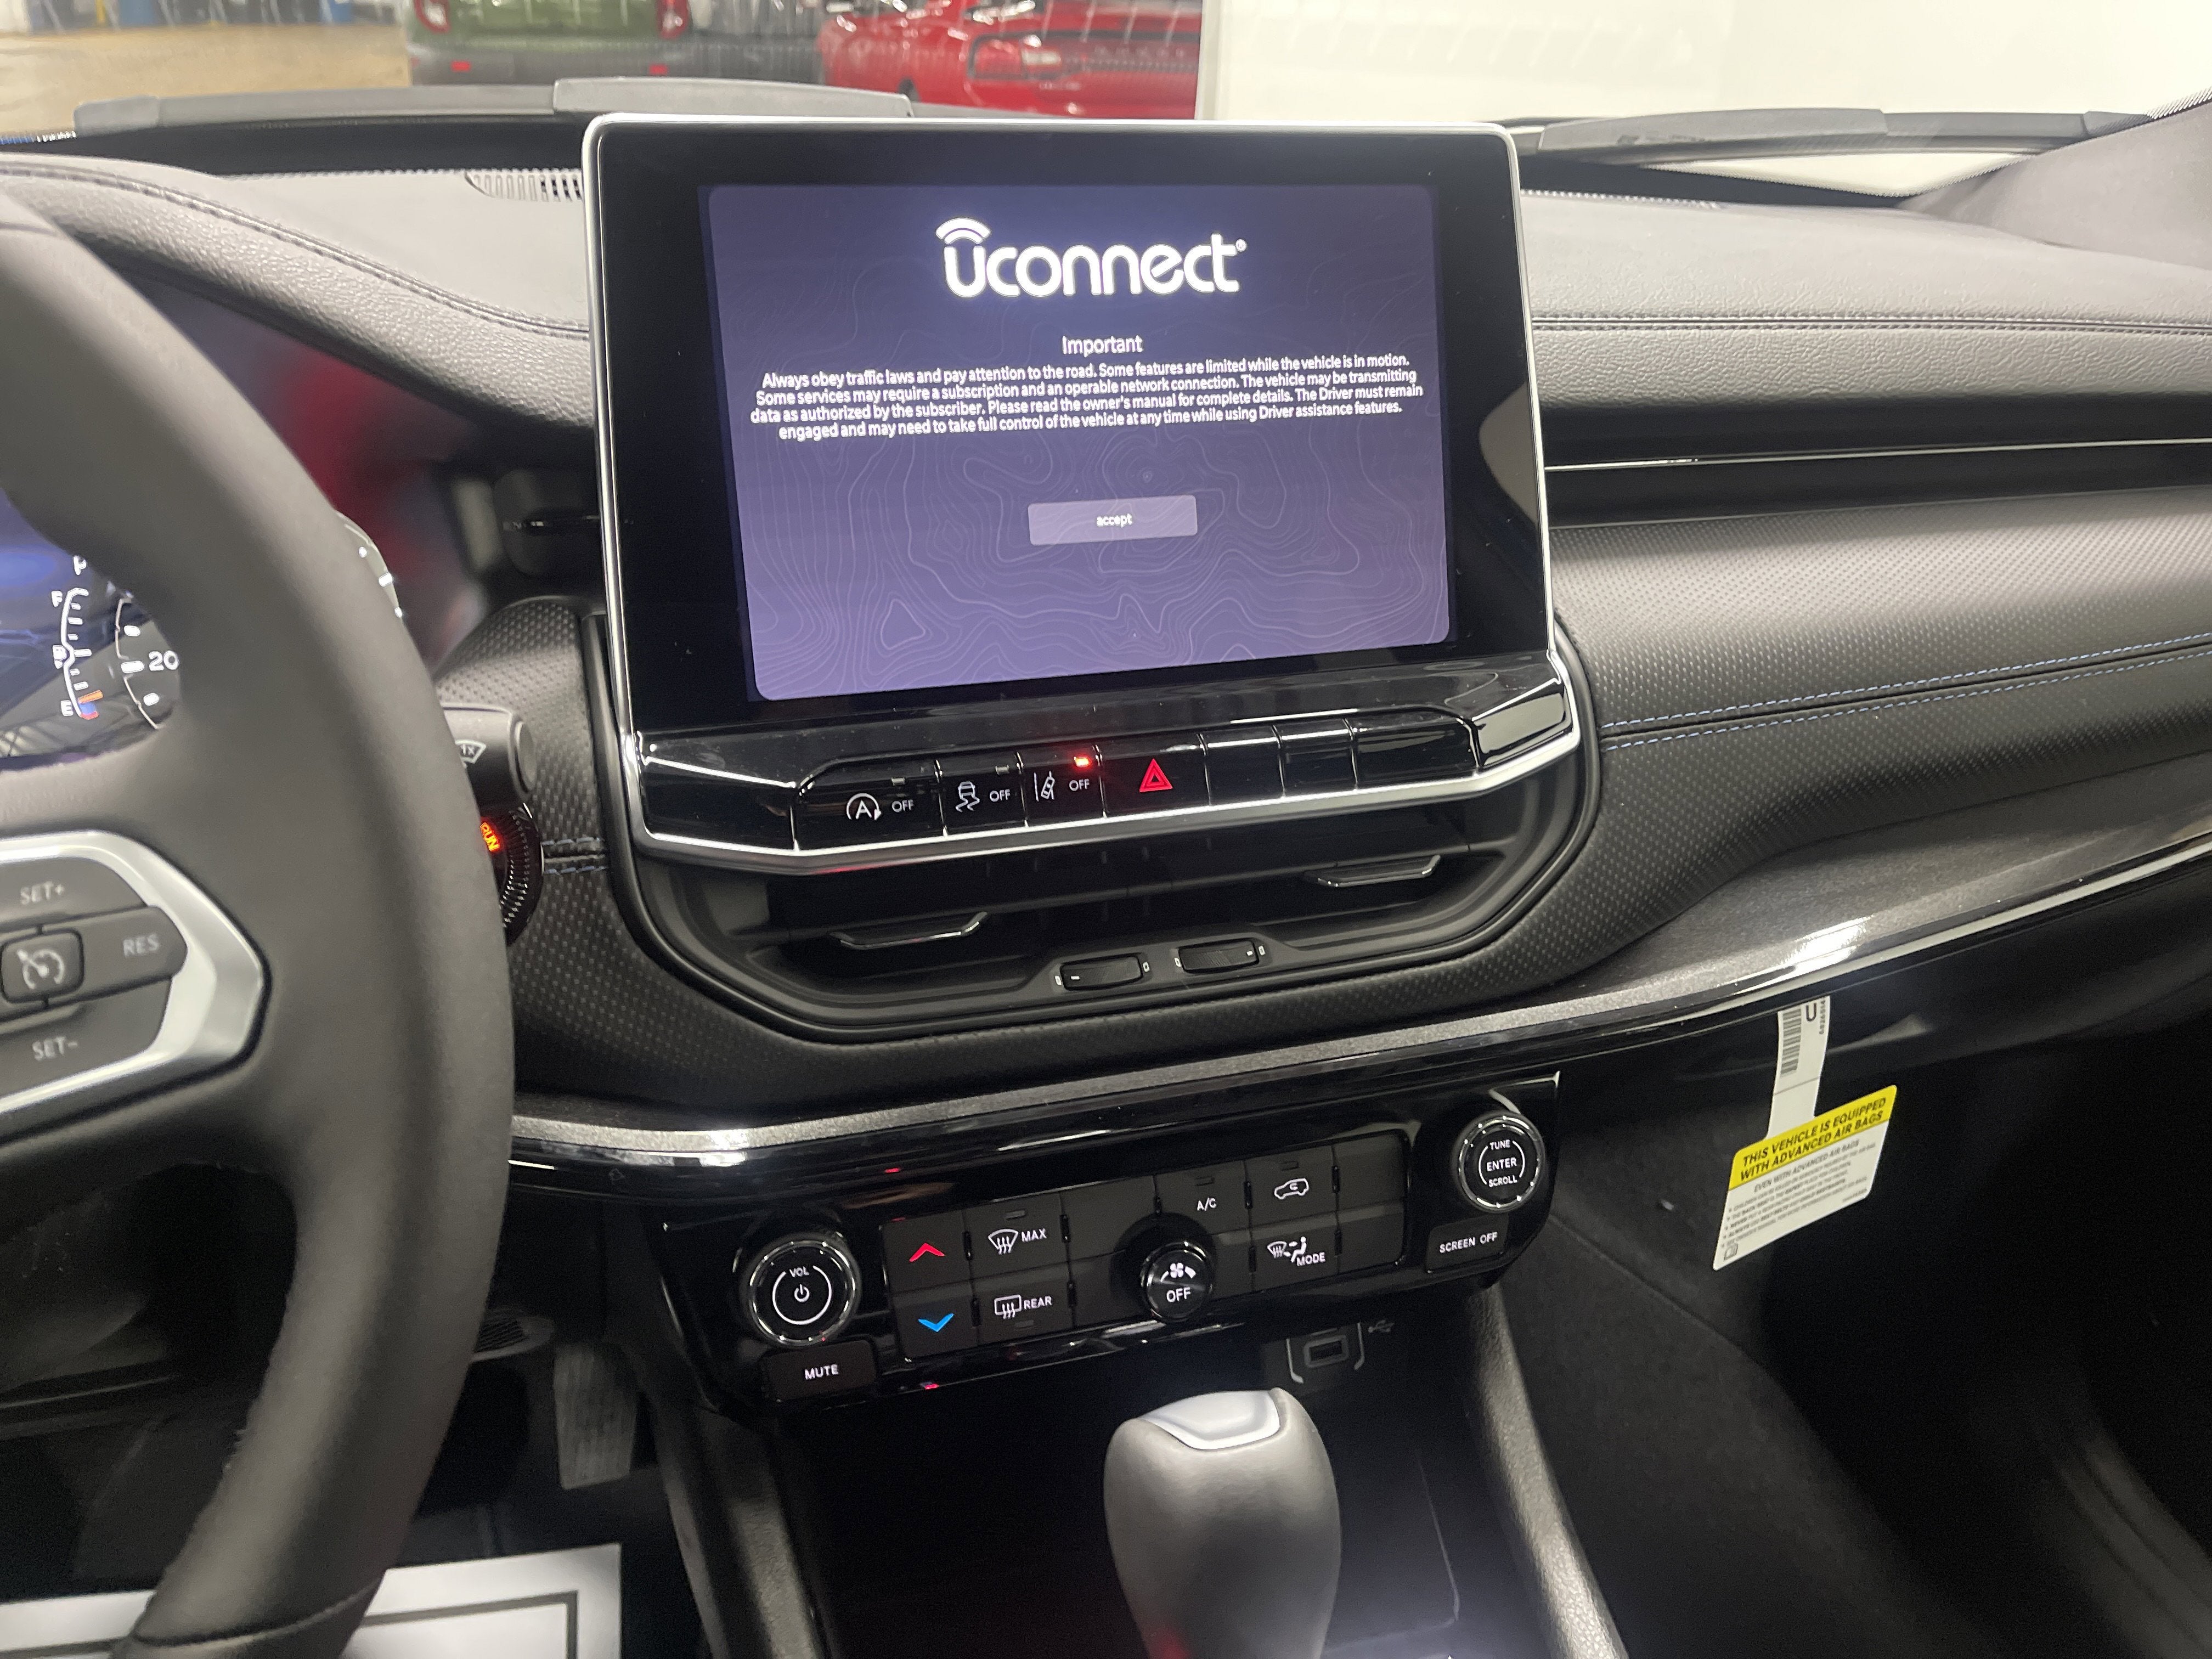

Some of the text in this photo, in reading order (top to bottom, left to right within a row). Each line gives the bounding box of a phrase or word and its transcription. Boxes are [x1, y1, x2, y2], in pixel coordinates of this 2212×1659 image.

[1062, 335, 1144, 358] Important
[762, 353, 1409, 390] Always obey traffic laws and pay attention to the road. Some features are limited while the vehicle is in motion.
[757, 369, 1417, 405] Some services may require a subscription and an operable network connection. The vehicle may be transmitting
[751, 384, 1423, 423] data as authorized by the subscriber. Please read the owner's manual for complete details. The Driver must remain
[779, 402, 1402, 441] engaged and may need to take full control of the vehicle at any time while using Driver assistance features.
[1097, 514, 1132, 527] accept
[52, 591, 63, 607] F
[149, 651, 179, 670] 20
[61, 701, 73, 716] E
[1069, 780, 1090, 792] OFF
[989, 789, 1011, 802] OFF
[892, 799, 913, 812] OFF
[20, 881, 65, 905] SET+
[123, 934, 160, 958] RES
[32, 1036, 78, 1061] SET-
[1743, 1097, 1886, 1166] THIS VEHICLE IS EQUIPPED
[1489, 1139, 1510, 1150] TUNE
[1740, 1110, 1883, 1181] WITH ADVANCED AIR BAGS
[1487, 1157, 1517, 1172] ENTER
[1488, 1175, 1517, 1187] SCROLL
[1197, 1197, 1216, 1211] A/C
[1022, 1228, 1047, 1242] MAX
[1440, 1232, 1498, 1254] SCREEN OFF
[1296, 1252, 1325, 1266] MODE
[789, 1266, 809, 1277] VOL
[1166, 1287, 1191, 1302] OFF
[1024, 1296, 1052, 1310] REAR
[804, 1364, 839, 1380] MUTE
